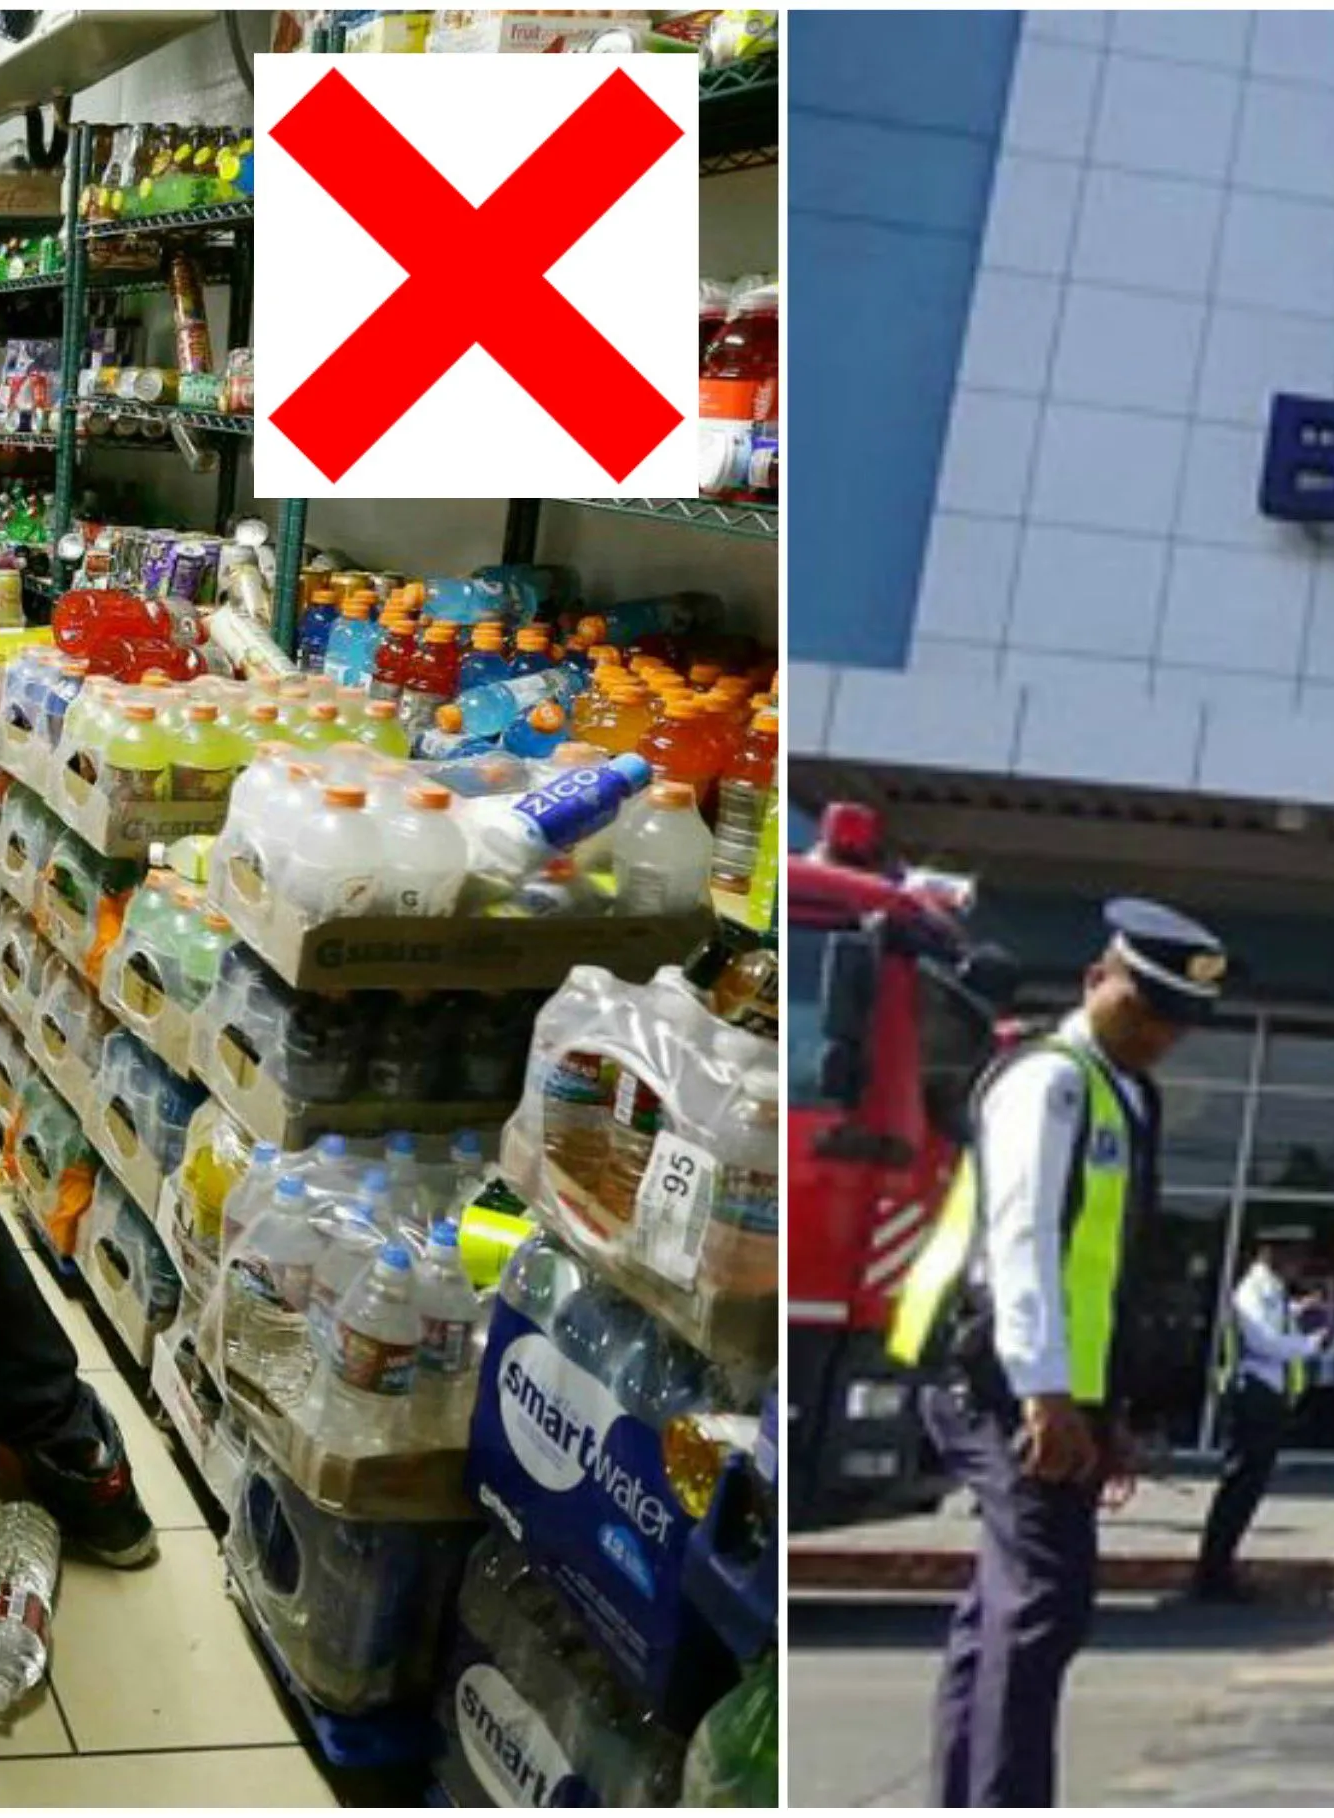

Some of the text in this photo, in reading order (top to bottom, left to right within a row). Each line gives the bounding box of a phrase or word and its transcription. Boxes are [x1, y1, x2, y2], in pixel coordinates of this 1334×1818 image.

[521, 769, 599, 817] ZICO
[401, 890, 420, 907] G
[662, 1152, 697, 1197] 95
